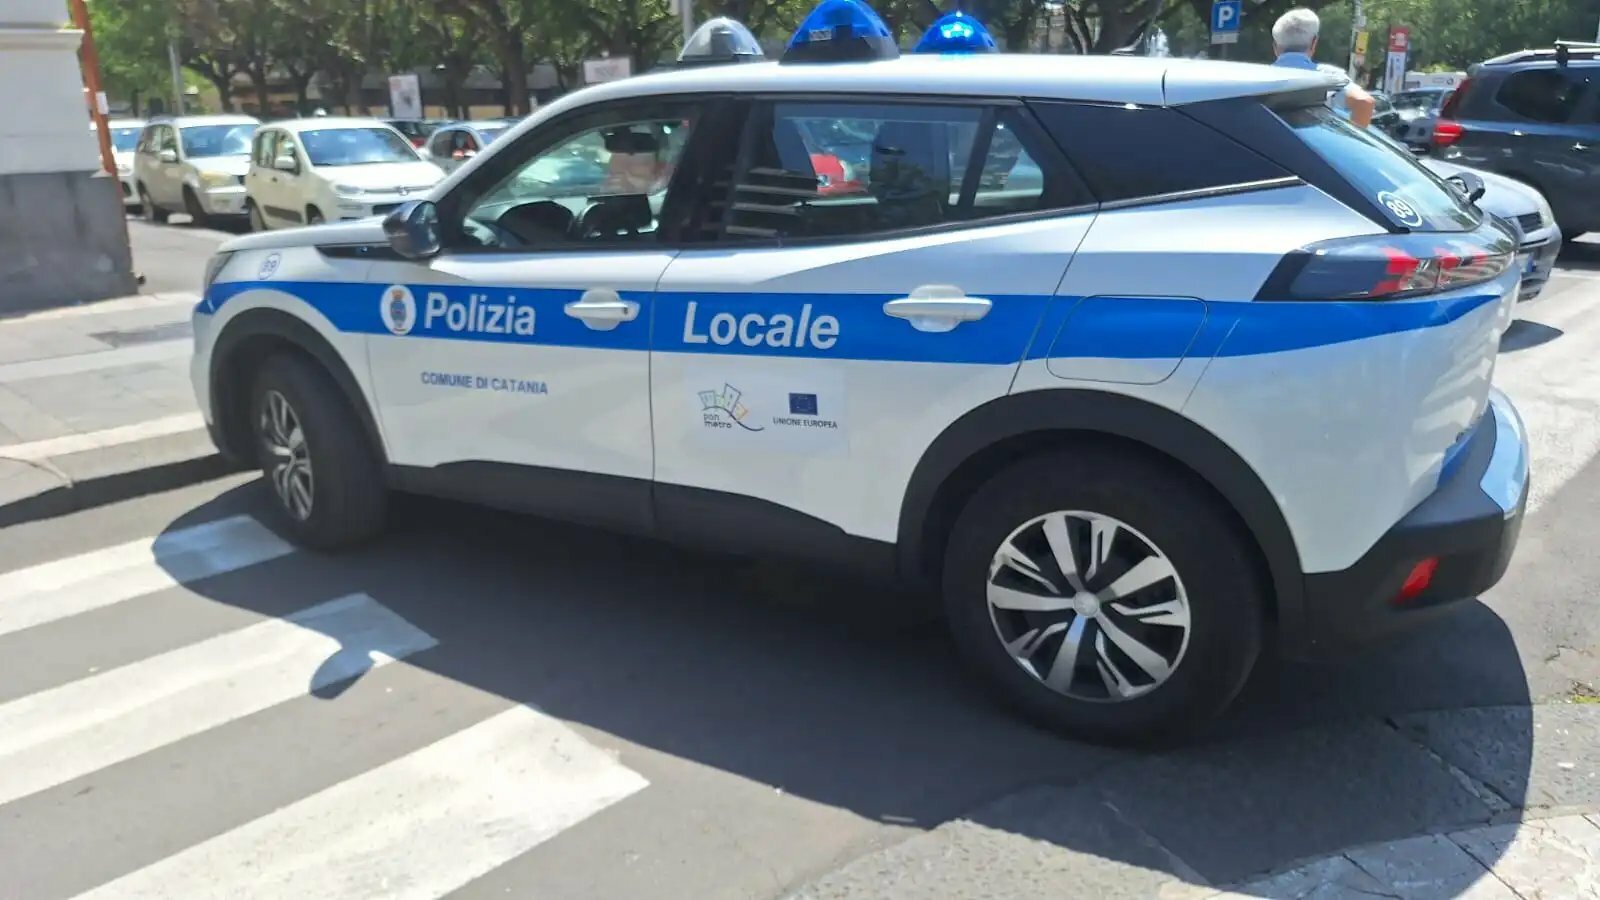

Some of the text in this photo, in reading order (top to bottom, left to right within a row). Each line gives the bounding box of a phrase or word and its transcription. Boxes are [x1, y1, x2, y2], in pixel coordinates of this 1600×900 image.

[1218, 5, 1234, 29] P
[1386, 199, 1414, 219] 89
[424, 291, 840, 350] Polizia Locale
[421, 371, 549, 395] COMUNE DI CATANIA
[773, 416, 839, 430] UNIONE EUROPEA
